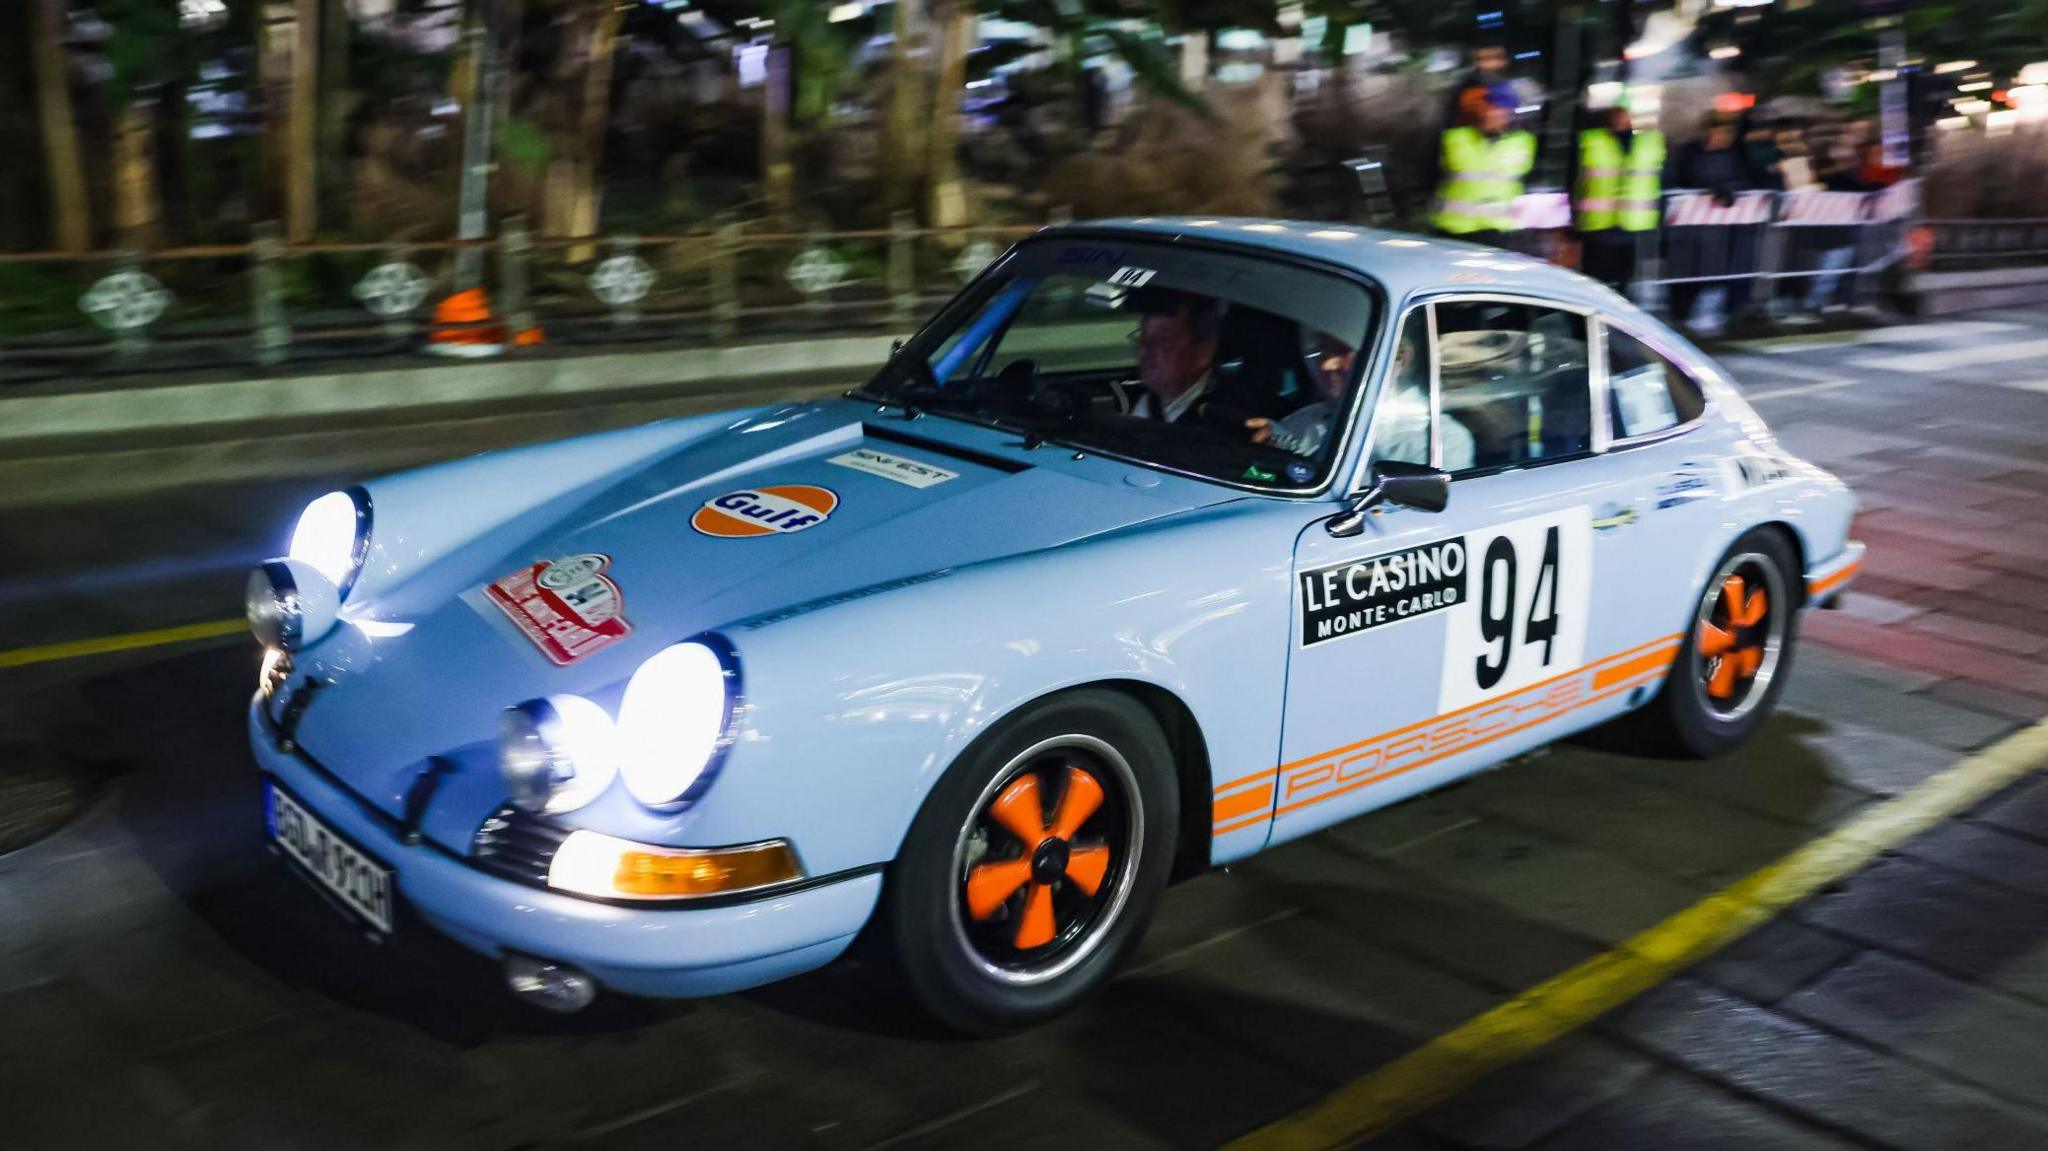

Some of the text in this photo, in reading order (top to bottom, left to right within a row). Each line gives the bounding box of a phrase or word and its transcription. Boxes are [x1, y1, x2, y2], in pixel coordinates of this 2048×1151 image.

[715, 493, 820, 530] Gulf
[1306, 543, 1465, 612] LE CASINO
[1476, 526, 1559, 690] 94
[1286, 678, 1584, 801] PORSCHE
